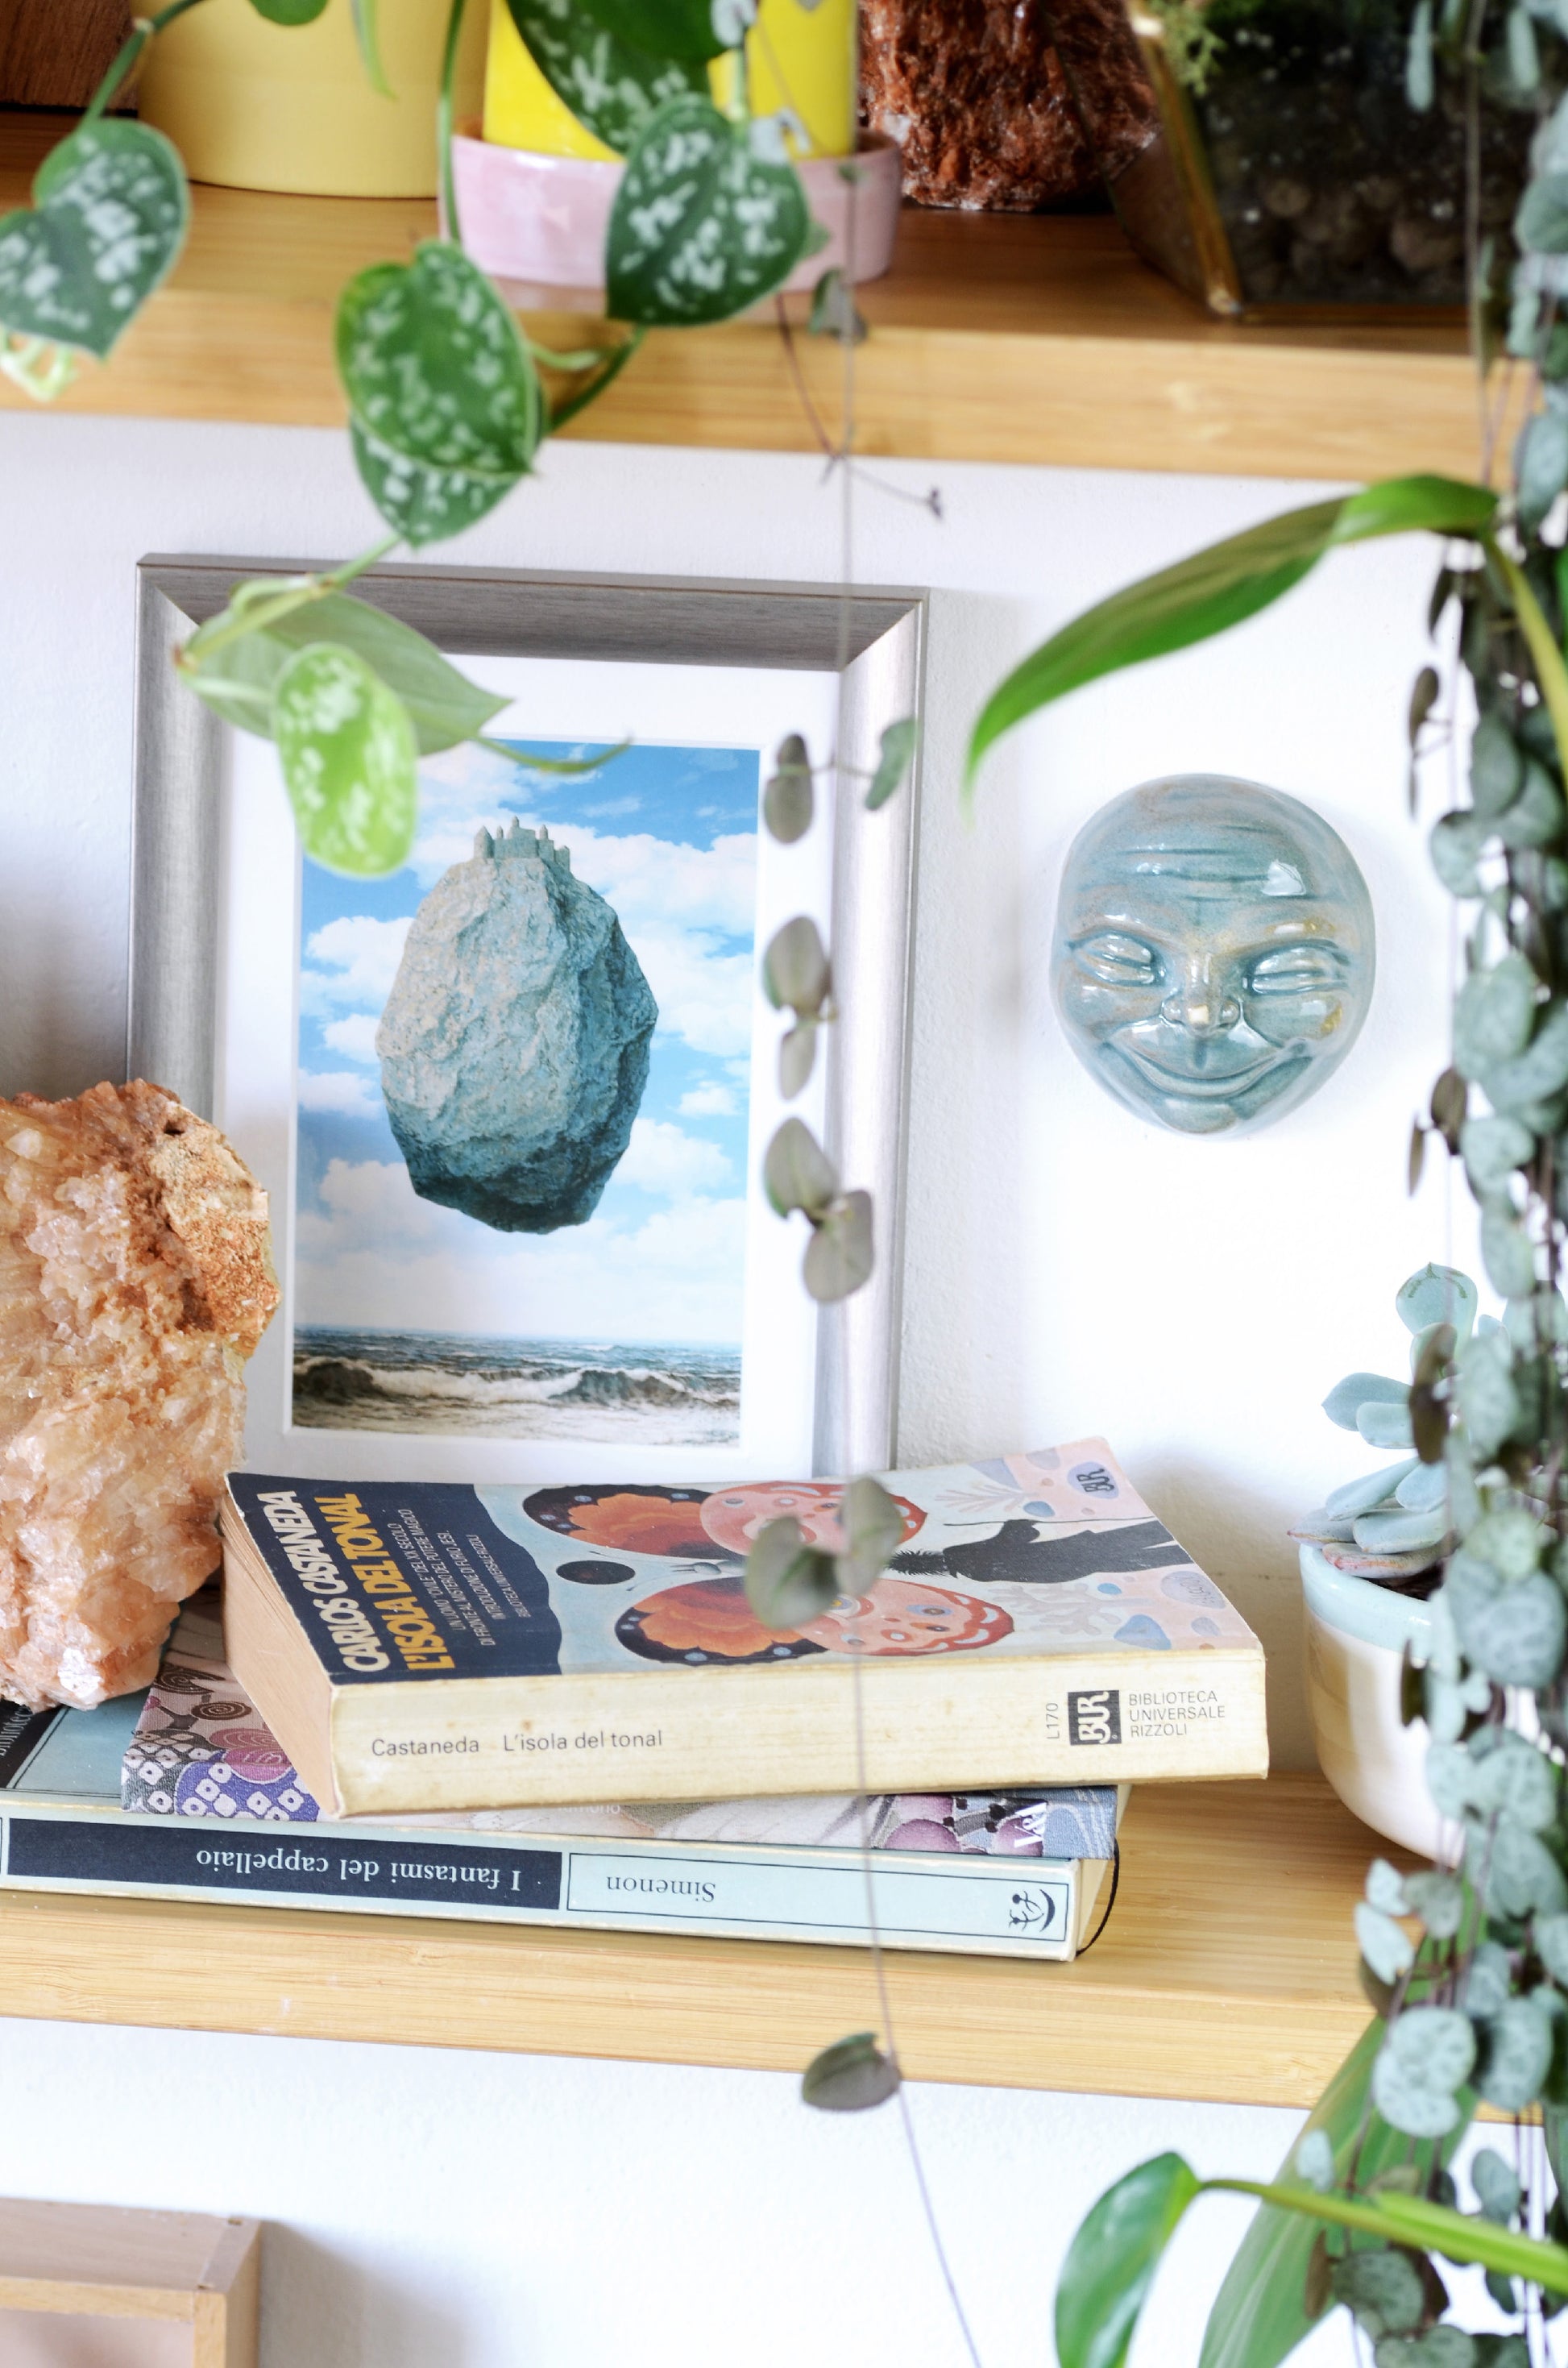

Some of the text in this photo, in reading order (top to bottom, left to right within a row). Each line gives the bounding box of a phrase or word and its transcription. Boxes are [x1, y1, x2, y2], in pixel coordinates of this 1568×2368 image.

[1076, 1469, 1114, 1492] BUR
[386, 1523, 414, 1549] SECOLO
[400, 1549, 421, 1559] XX
[406, 1559, 429, 1572] DEL
[445, 1546, 471, 1566] FURIO
[256, 1491, 391, 1672] CARLOS CASTANEDA
[314, 1493, 456, 1670] L'ISOLA DEL TONAL
[396, 1508, 496, 1645] DI FRONTE AL MISTERO DEL POTERE MAGICO
[466, 1535, 531, 1617] BIBLIOTECA UNIVERSALE RIZZOLI
[433, 1599, 459, 1618] UOMO
[463, 1573, 506, 1618] INTRODUZIONE
[446, 1618, 466, 1630] UN
[1129, 1690, 1218, 1706] BIBLIOTECA
[1046, 1702, 1060, 1739] L170
[1076, 1691, 1113, 1744] BUR
[1129, 1705, 1226, 1722] UNIVERSALE
[371, 1730, 662, 1756] Castaneda L'isola del tonal
[1130, 1723, 1188, 1738] RIZZOLI
[1014, 1802, 1047, 1848] V&A
[196, 1847, 522, 1892] I fantasmi del cappellaio
[606, 1876, 716, 1903] Simenon
